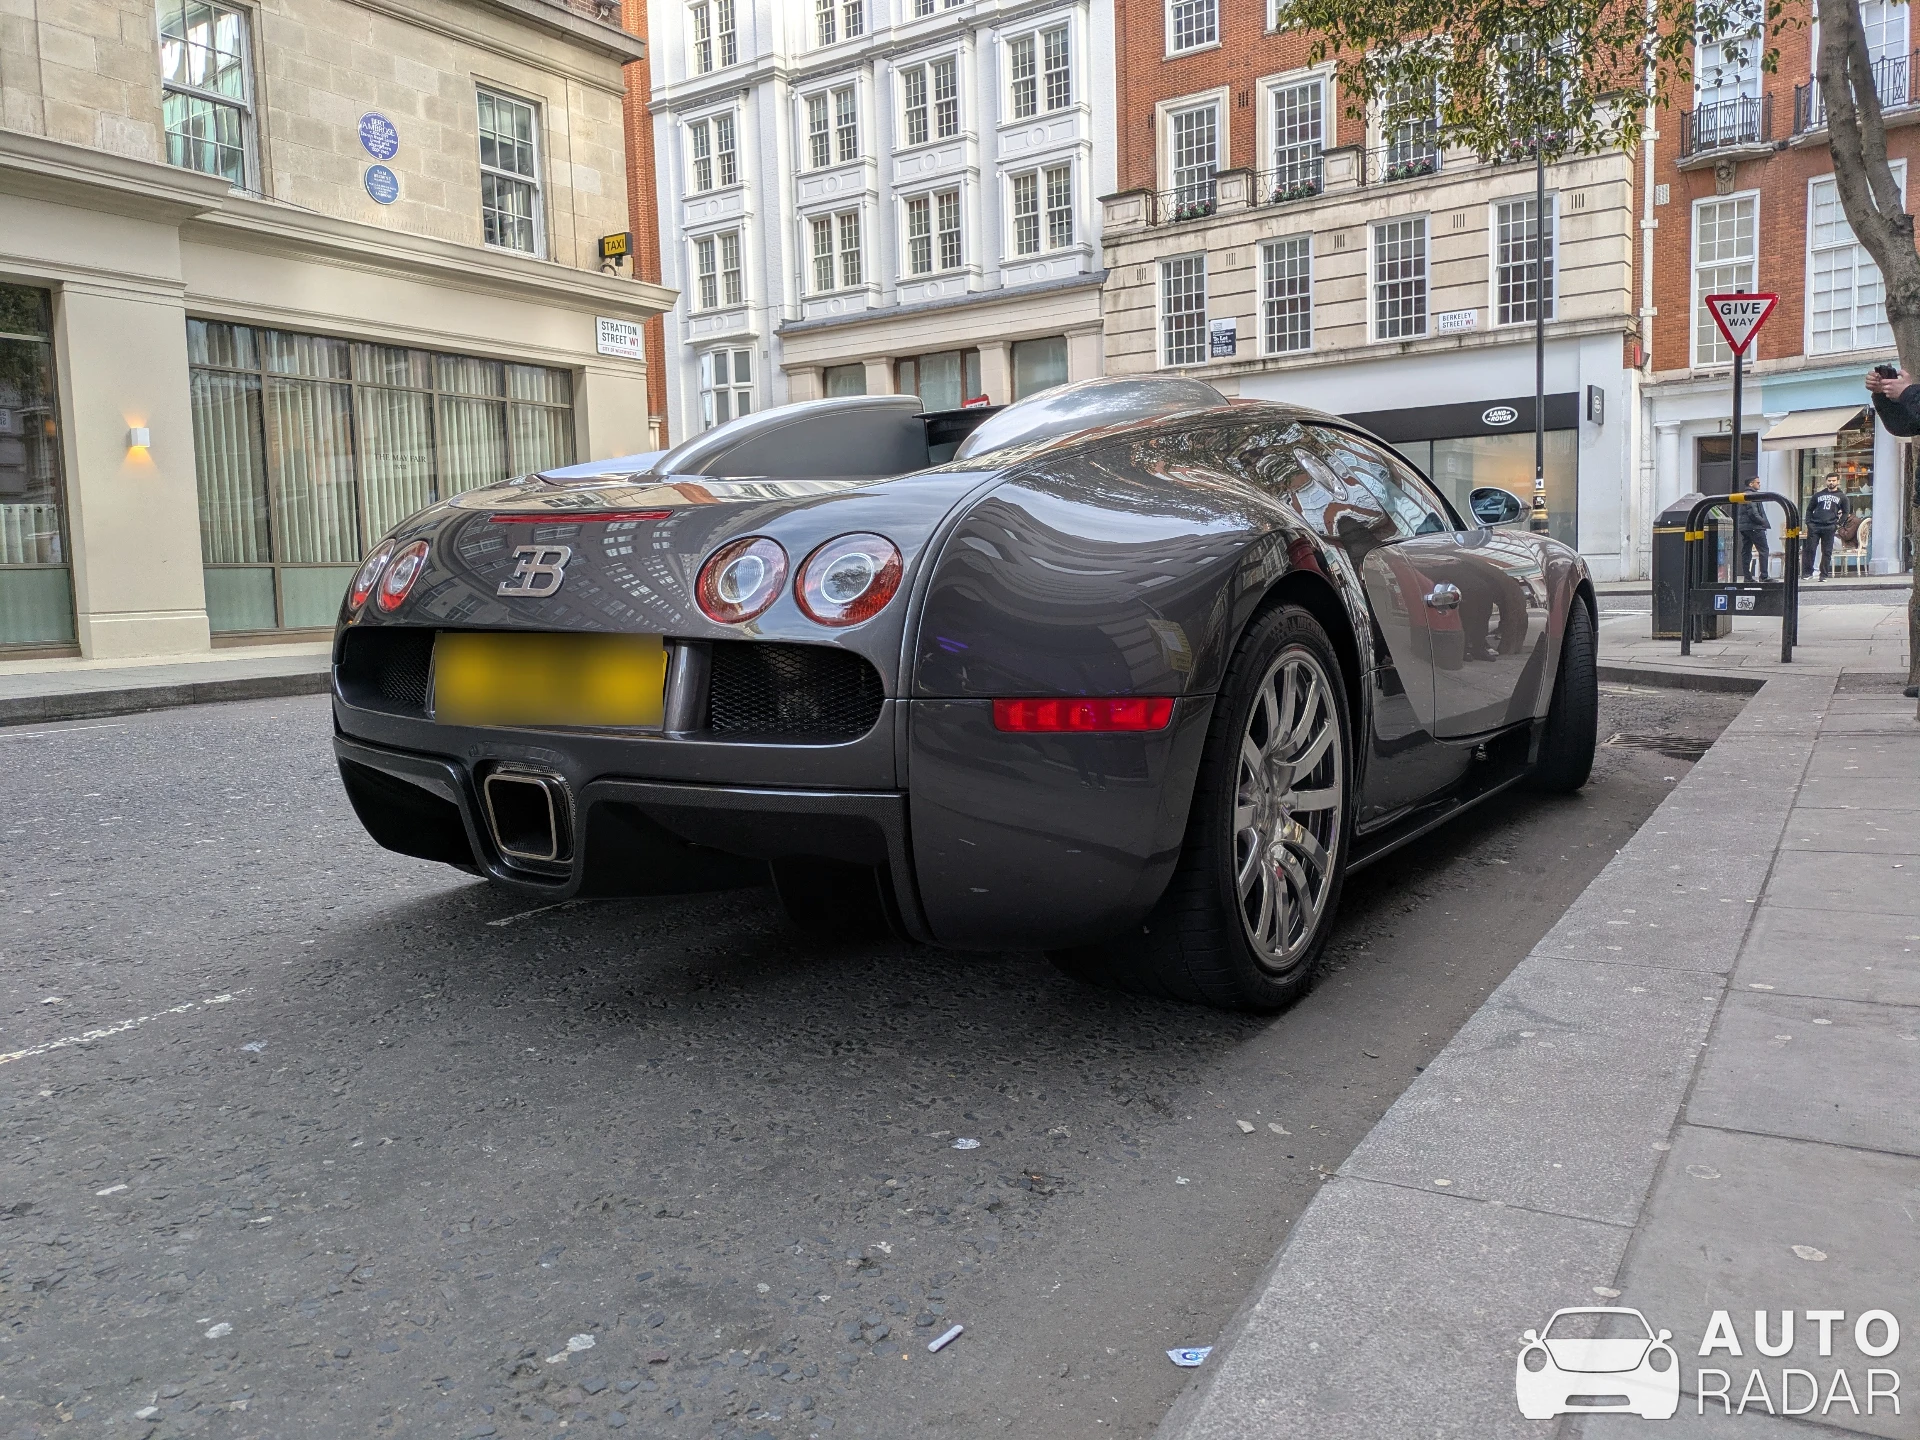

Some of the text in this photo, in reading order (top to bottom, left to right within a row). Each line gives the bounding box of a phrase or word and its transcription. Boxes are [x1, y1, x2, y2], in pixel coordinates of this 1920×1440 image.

[605, 239, 624, 251] TAXI
[1720, 302, 1761, 315] GIVE
[1442, 312, 1472, 322] BERKELEY
[1729, 317, 1755, 327] WAY
[601, 321, 637, 335] STRATTON
[1442, 318, 1474, 329] STREET W1
[601, 332, 639, 347] STREET W1
[1716, 418, 1733, 433] 13
[410, 455, 426, 463] FAIR
[1817, 494, 1841, 505] HOUSTON
[1823, 500, 1832, 510] 13
[1718, 597, 1725, 608] P
